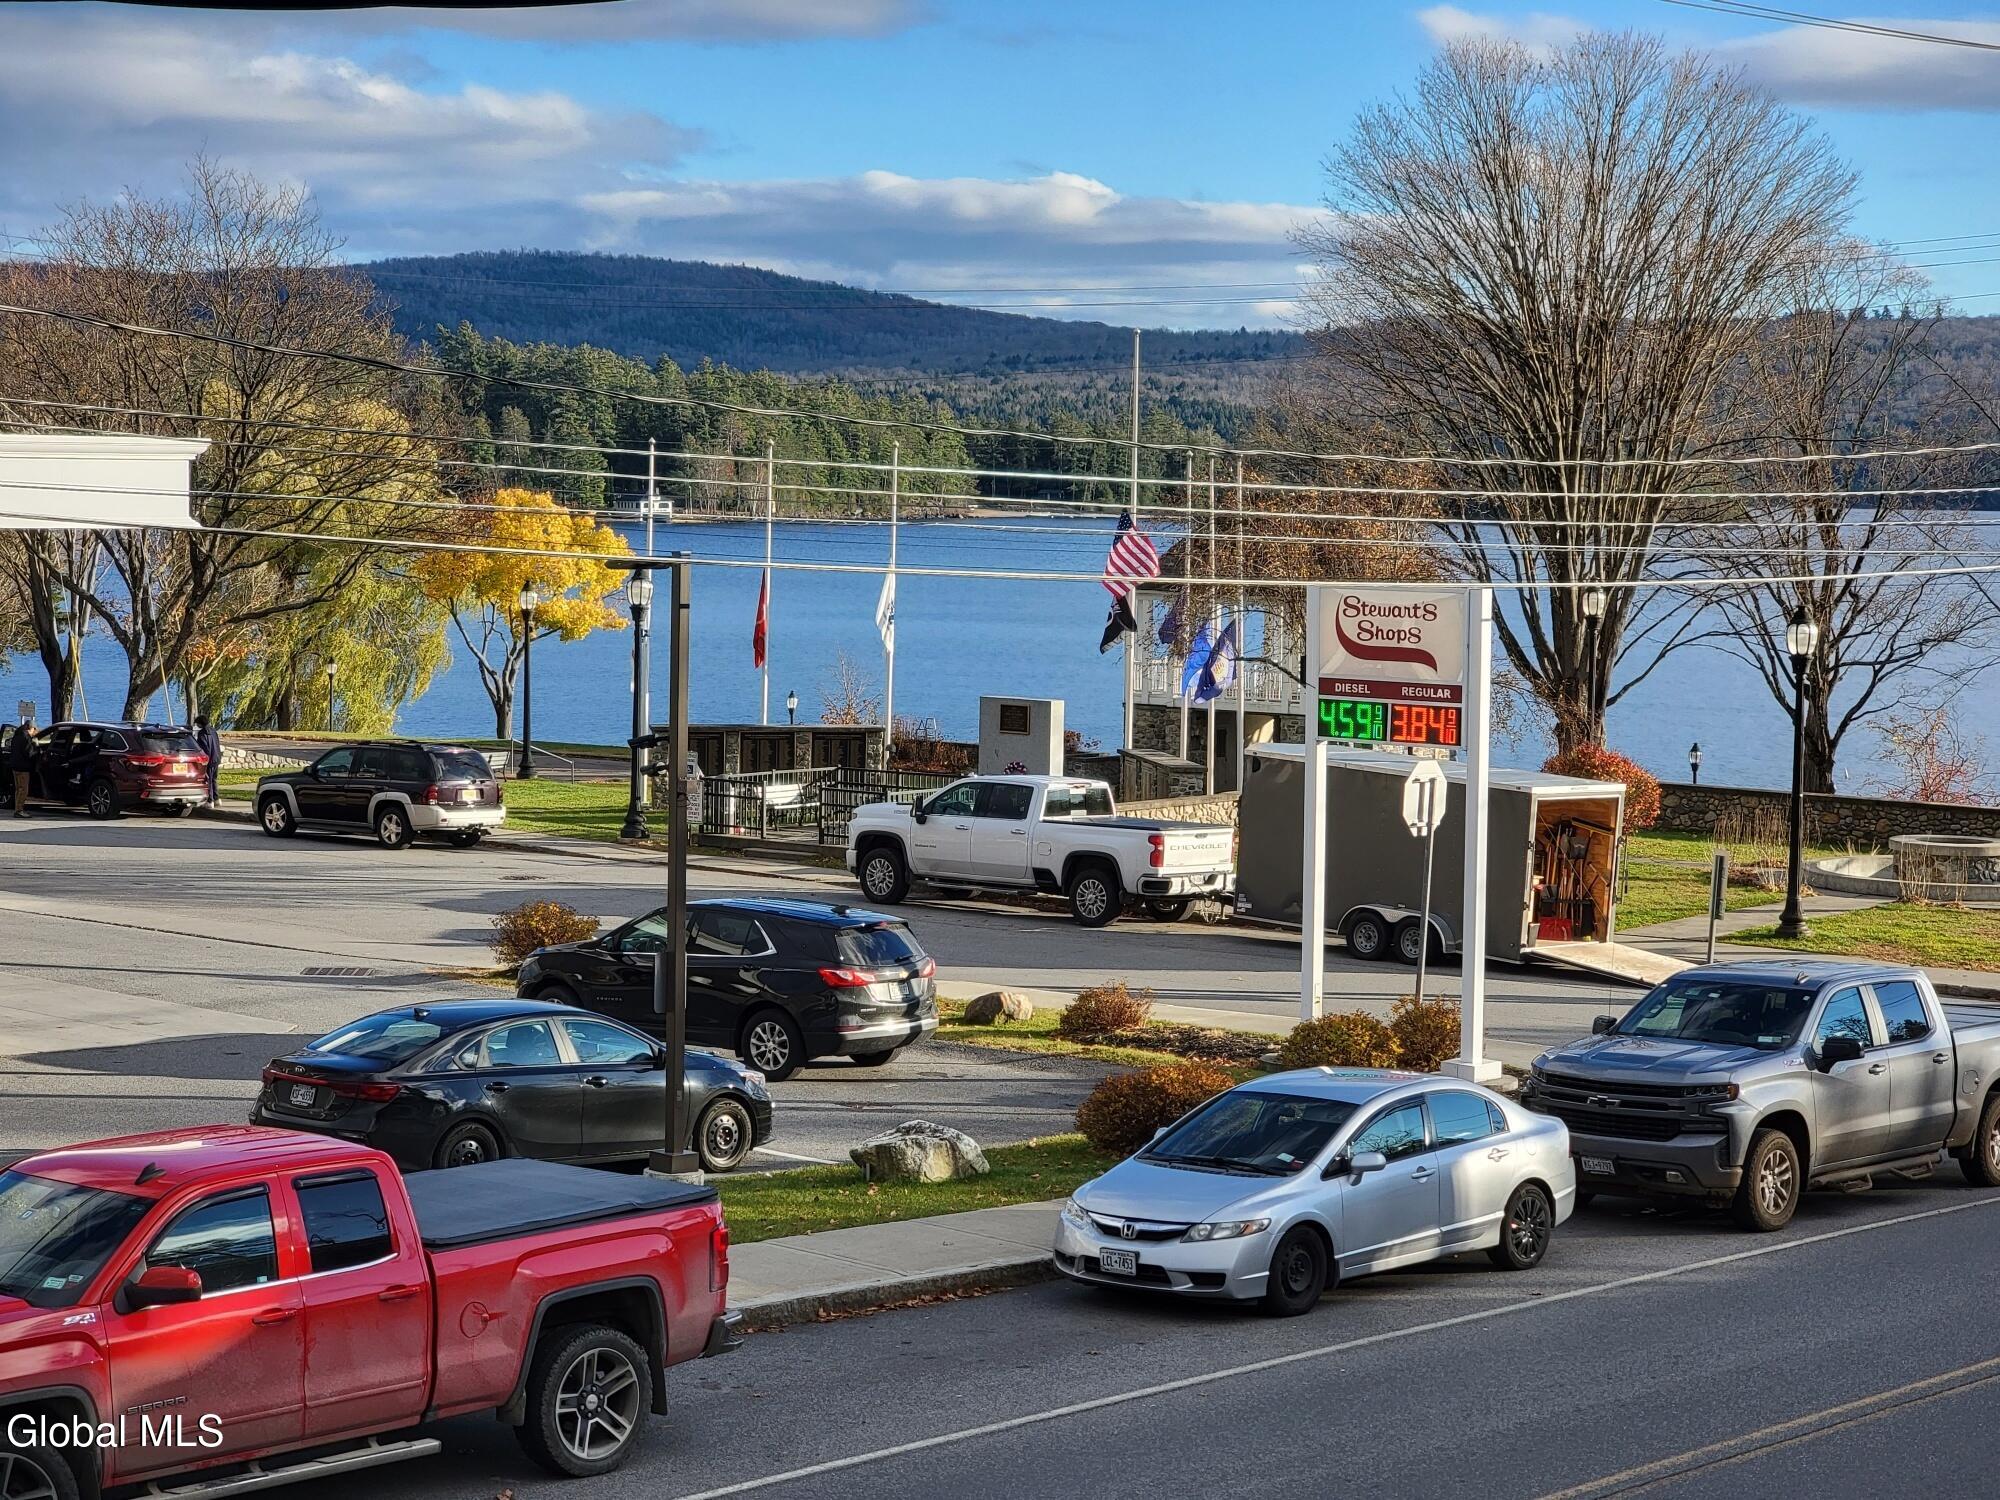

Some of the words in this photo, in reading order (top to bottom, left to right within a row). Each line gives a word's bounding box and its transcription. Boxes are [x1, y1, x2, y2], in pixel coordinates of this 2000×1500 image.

[1357, 620, 1422, 644] Shops
[1335, 683, 1371, 694] DIESEL
[1401, 687, 1452, 699] REGULAR
[1169, 842, 1228, 851] CHEVROLET
[127, 1396, 188, 1414] SIERRA
